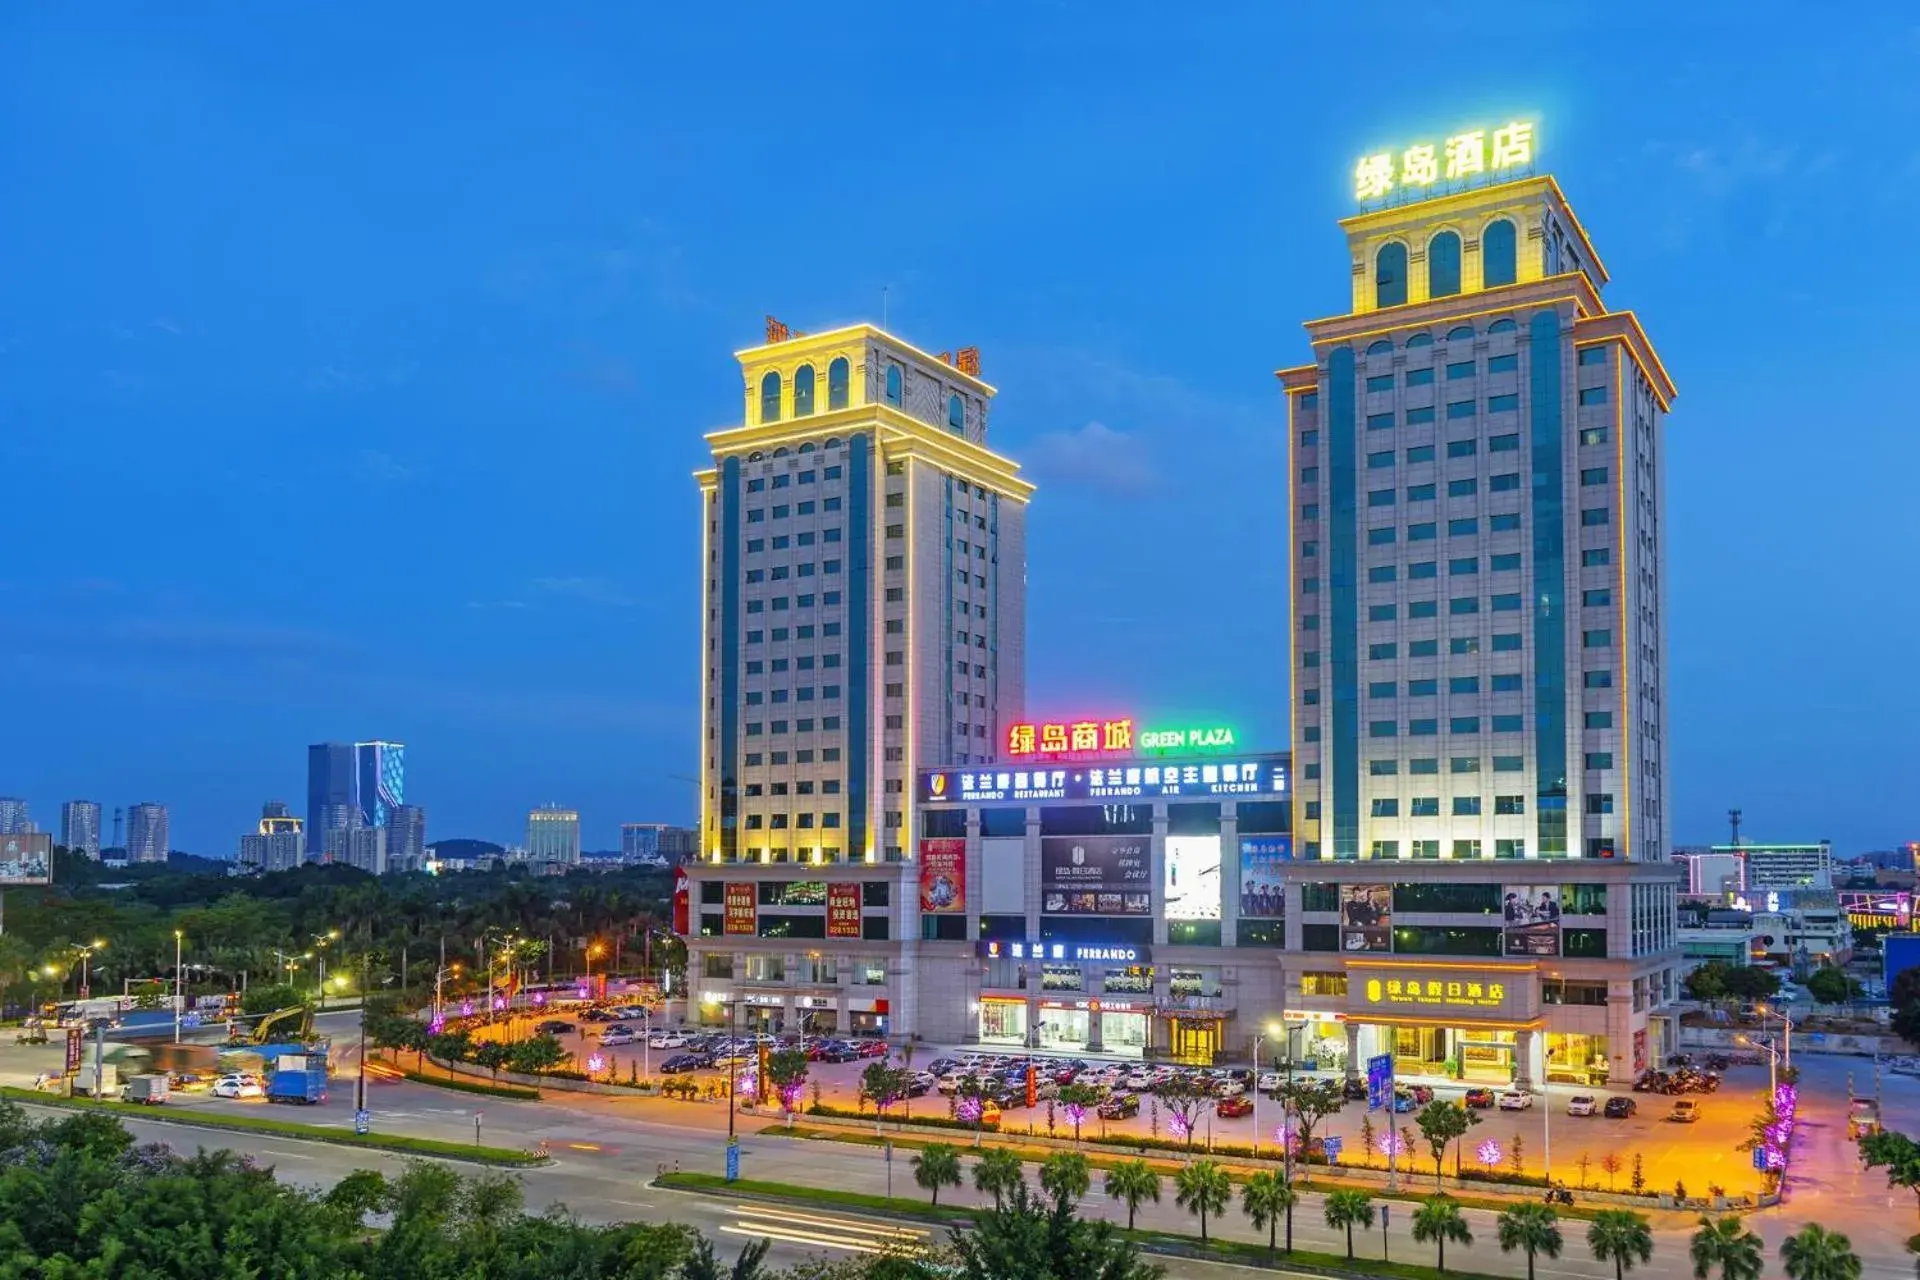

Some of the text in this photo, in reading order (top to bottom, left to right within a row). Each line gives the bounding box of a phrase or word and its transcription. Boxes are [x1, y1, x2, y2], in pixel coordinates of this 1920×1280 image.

[1355, 121, 1533, 200] 绿岛酒店
[1009, 719, 1132, 754] 绿岛商城
[1141, 727, 1235, 749] GREEN PLAZA
[1077, 947, 1136, 960] FERRANDO
